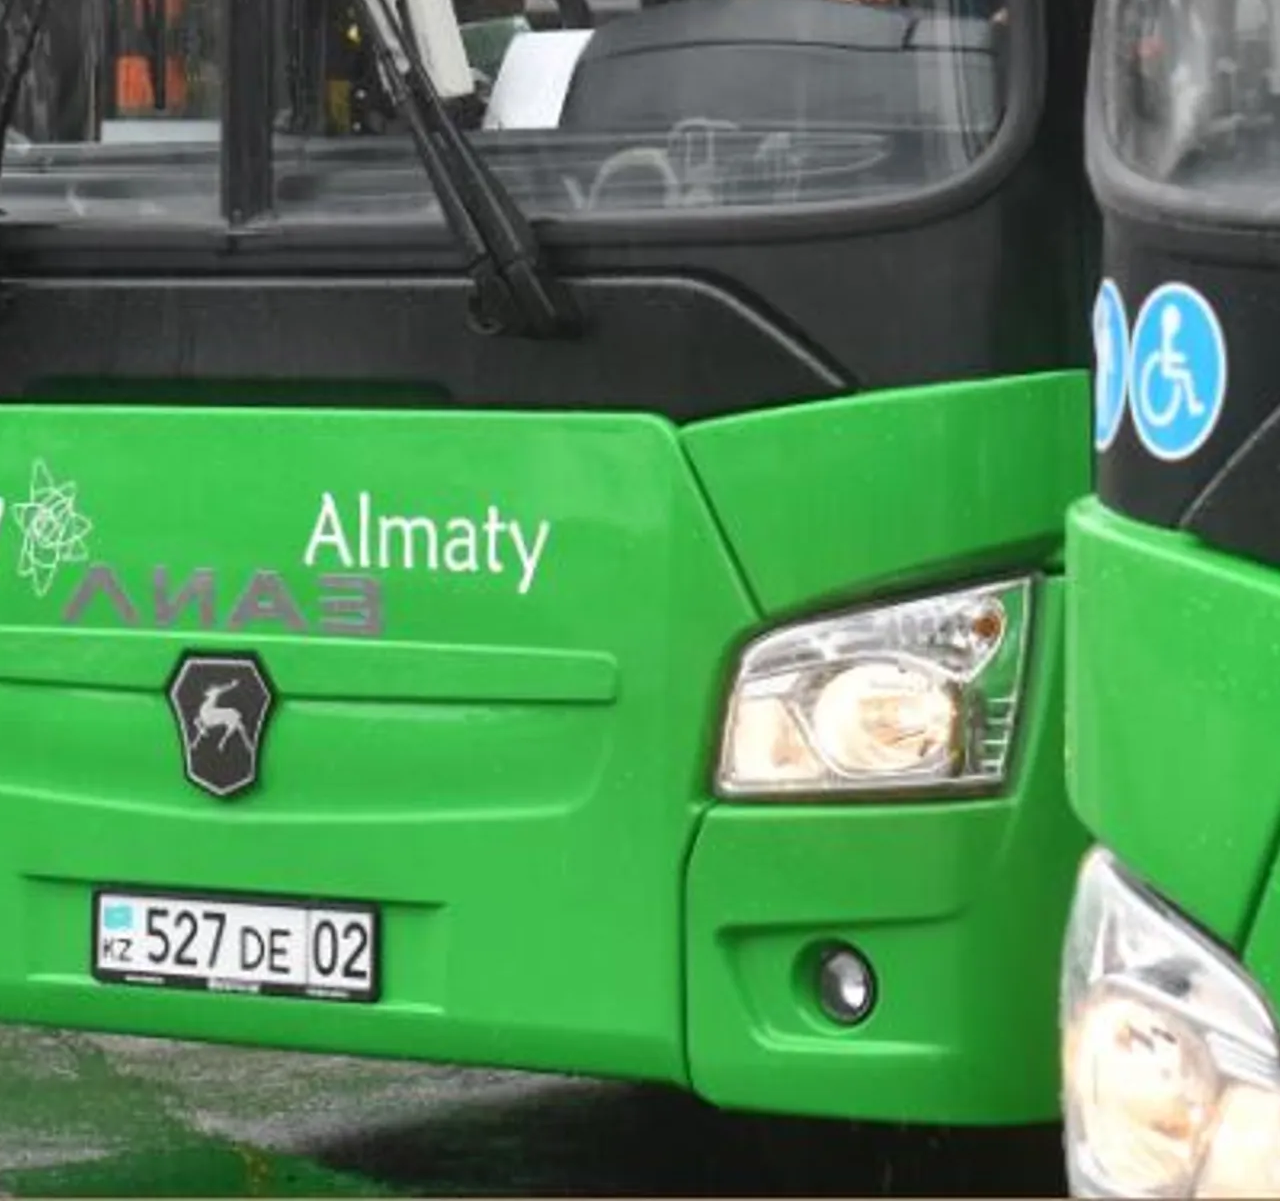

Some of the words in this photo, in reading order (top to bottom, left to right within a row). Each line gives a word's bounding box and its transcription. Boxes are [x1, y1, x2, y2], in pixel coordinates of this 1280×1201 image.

[303, 491, 551, 594] Almaty
[102, 938, 133, 962] KZ
[146, 908, 227, 969] 527
[239, 925, 292, 975] DE
[313, 918, 368, 979] 02
